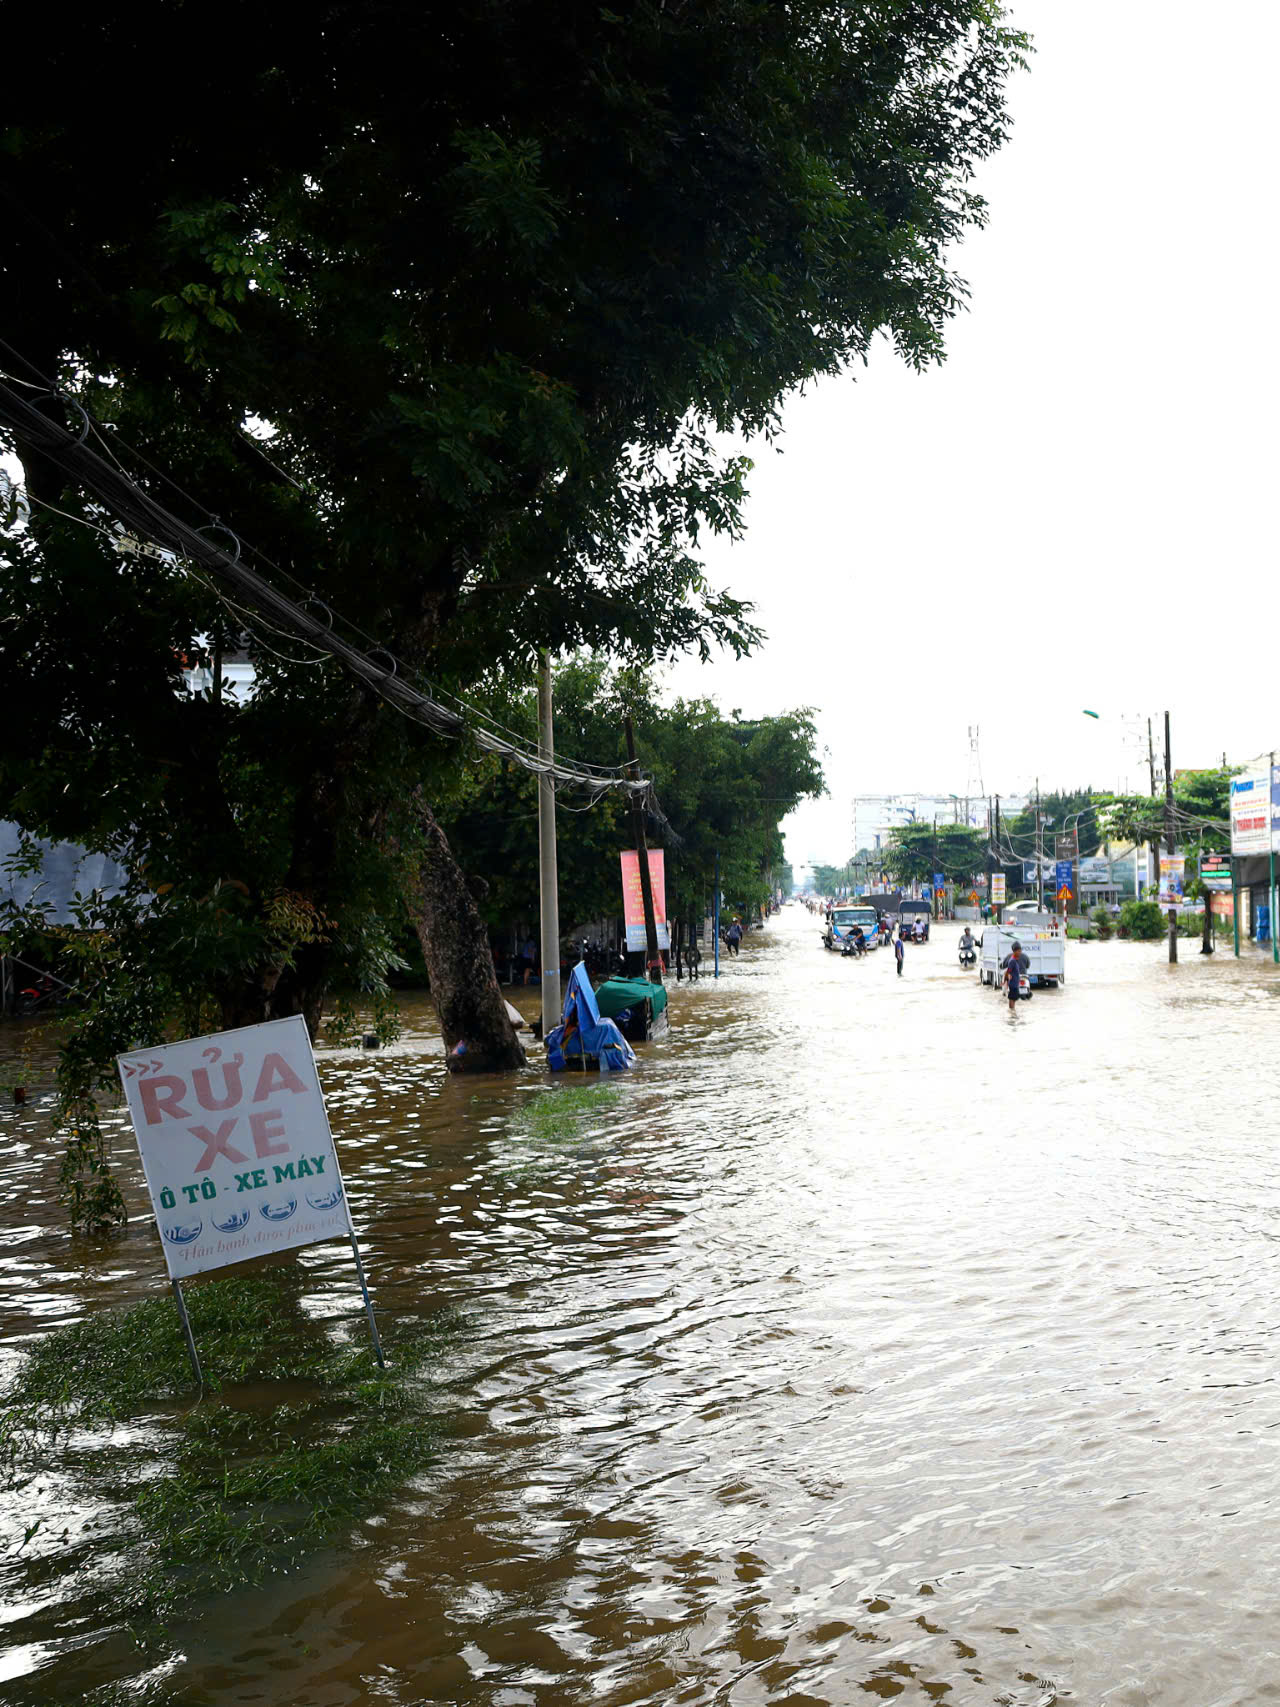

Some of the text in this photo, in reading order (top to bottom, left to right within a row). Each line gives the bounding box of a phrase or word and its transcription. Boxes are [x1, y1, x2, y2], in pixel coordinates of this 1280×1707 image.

[138, 1047, 309, 1126] RỬA
[187, 1108, 290, 1174] XE
[160, 1154, 326, 1209] Ô TÔ XE MÁY
